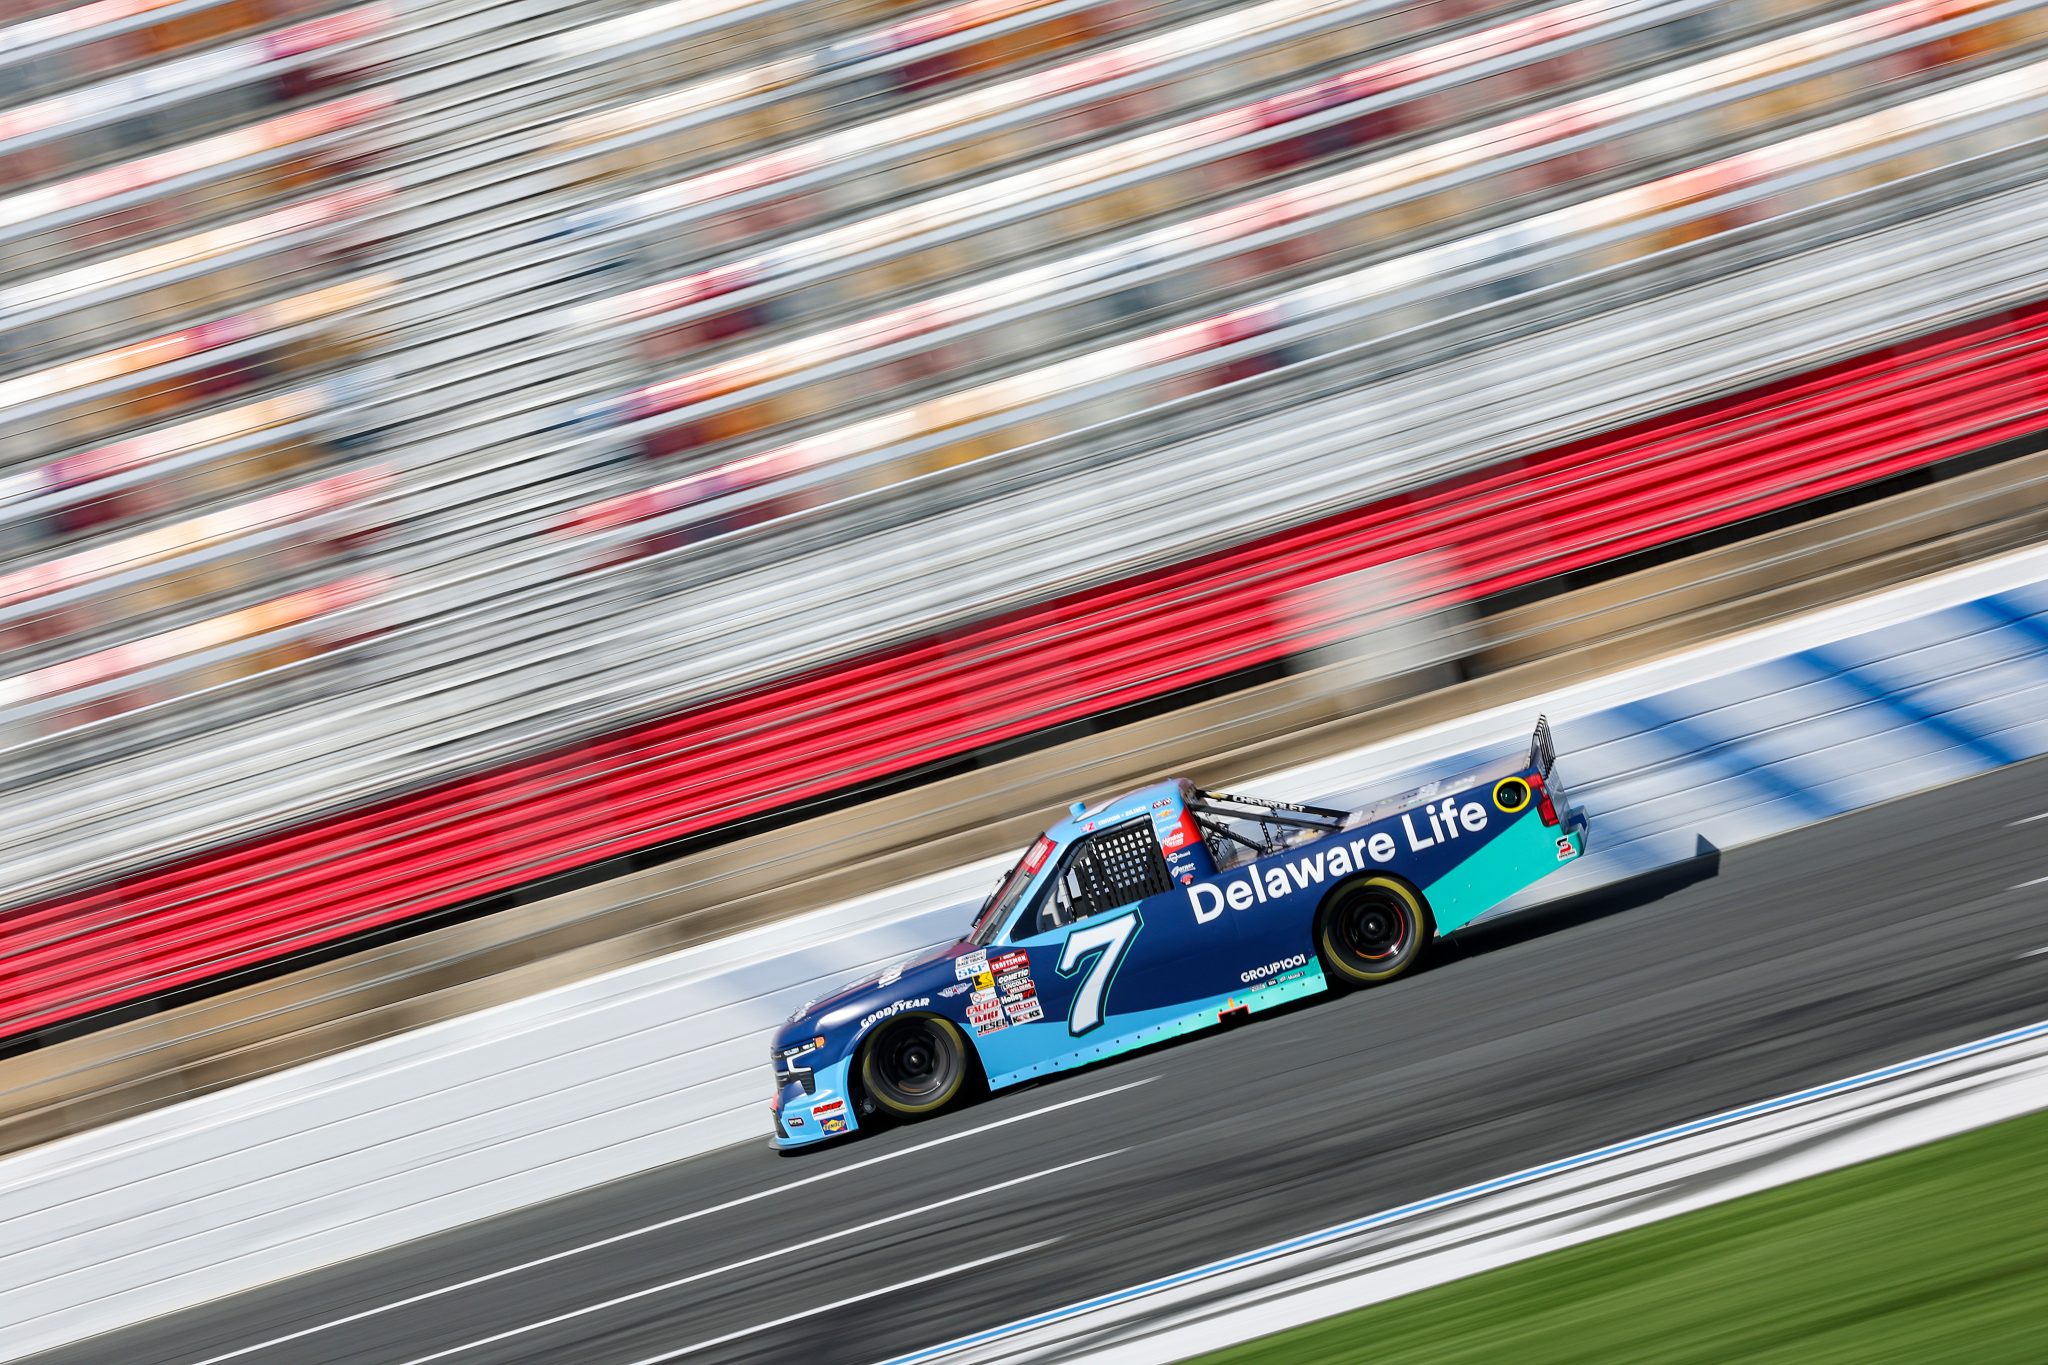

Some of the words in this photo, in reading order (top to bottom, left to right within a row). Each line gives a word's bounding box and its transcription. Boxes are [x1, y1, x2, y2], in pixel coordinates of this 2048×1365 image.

[1232, 795, 1306, 812] CHEVROLET
[1187, 832, 1396, 924] Delaware
[1401, 798, 1488, 852] Life
[957, 962, 987, 978] SKF
[992, 955, 1027, 970] CRAFTSMAN
[1241, 954, 1306, 982] GROUP1001
[998, 969, 1029, 984] COMETIC
[1058, 911, 1142, 1035] 7
[1003, 979, 1027, 991] LINCOLN
[1001, 993, 1023, 1005] Holley
[1008, 1000, 1037, 1013] tilton
[860, 998, 930, 1029] GOODYEAR
[978, 1019, 1008, 1033] JESEL
[813, 1100, 843, 1115] ARP
[823, 1119, 846, 1132] SUNOCO
